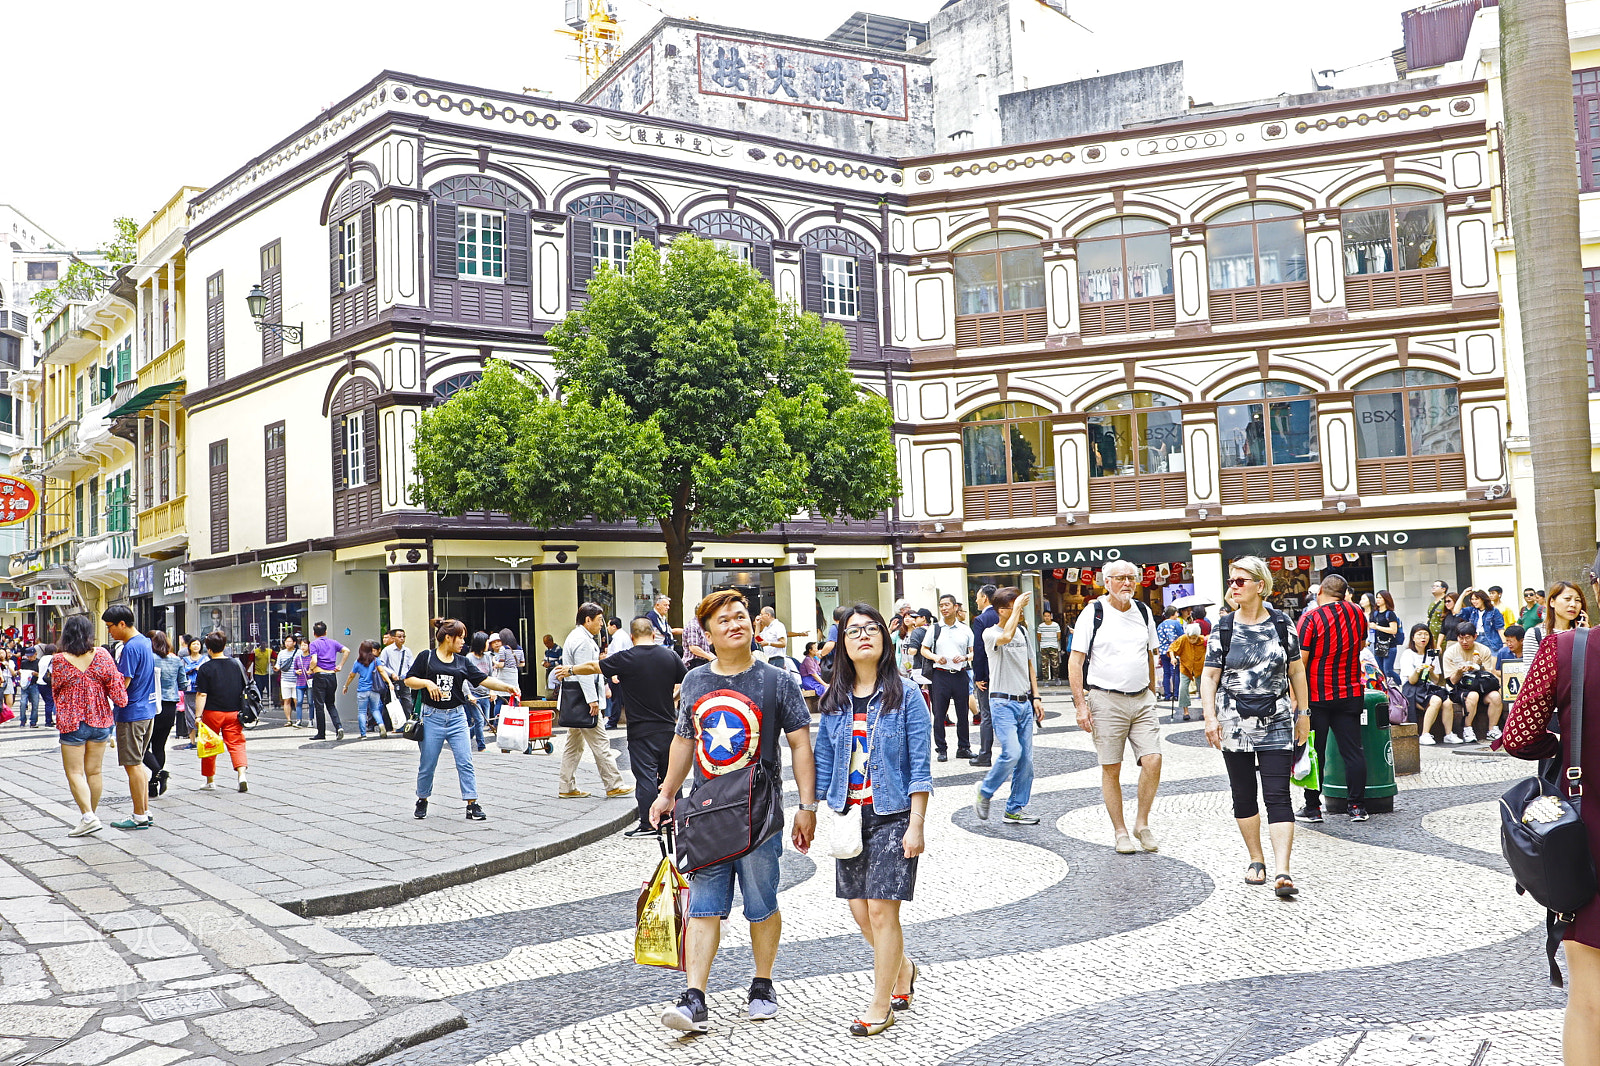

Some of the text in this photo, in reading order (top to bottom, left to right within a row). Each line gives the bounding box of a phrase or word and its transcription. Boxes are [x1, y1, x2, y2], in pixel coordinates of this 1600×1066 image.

[1147, 133, 1217, 154] 2000
[1361, 409, 1397, 424] BSX
[1143, 426, 1176, 441] BSX
[1270, 532, 1409, 553] GIORDANO
[260, 558, 298, 577] LONGINES
[995, 548, 1121, 568] GIORDANO
